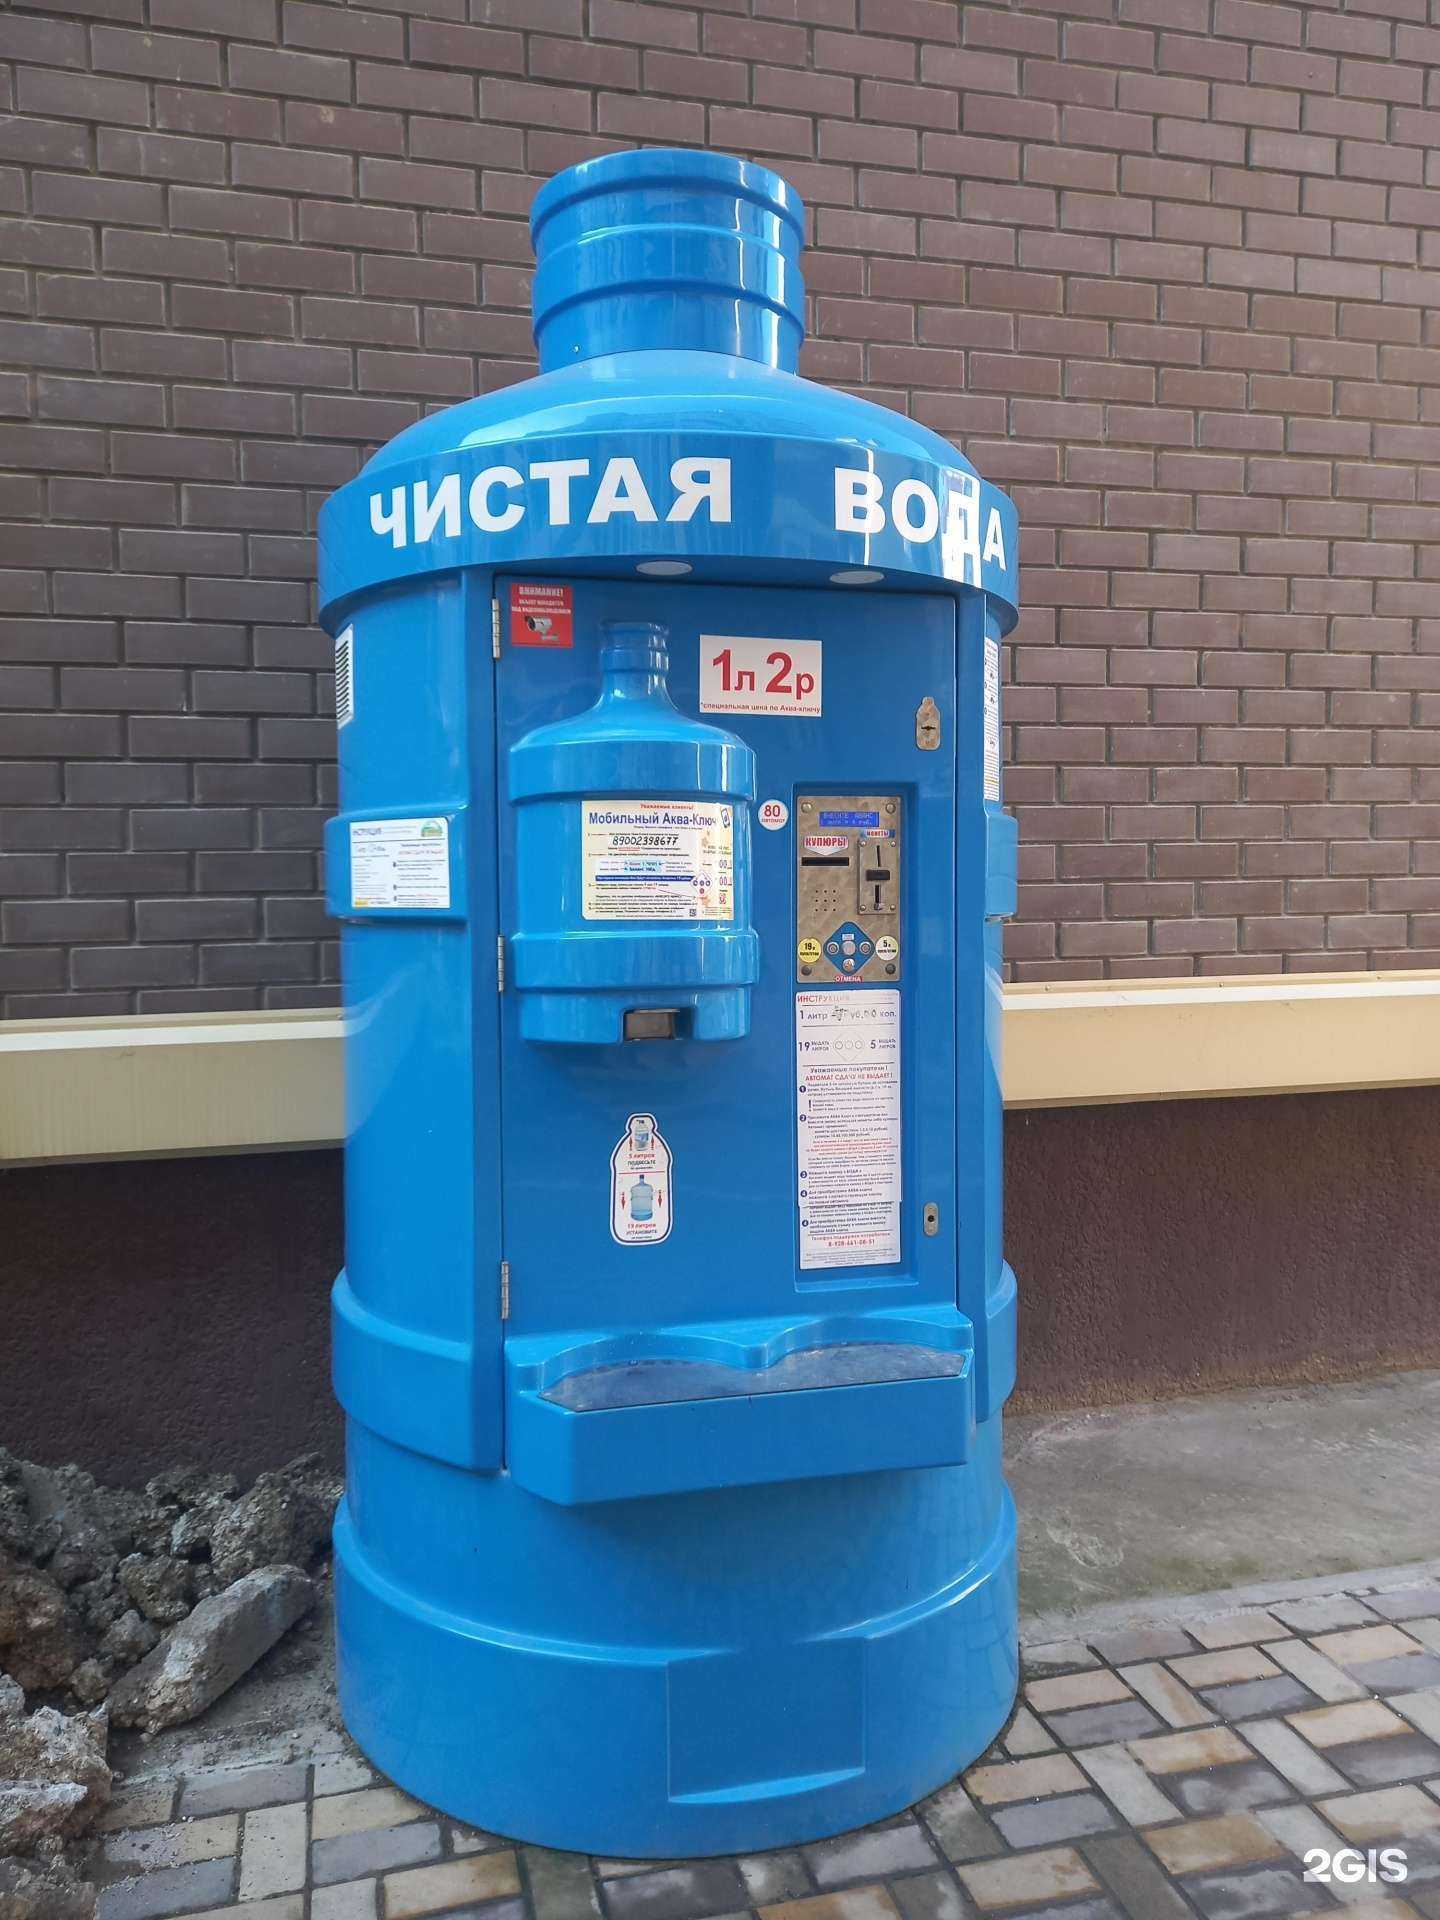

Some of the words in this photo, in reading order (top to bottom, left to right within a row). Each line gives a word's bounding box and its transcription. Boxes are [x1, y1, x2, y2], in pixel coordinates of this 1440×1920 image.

[370, 456, 732, 549] ЧИСТАЯ
[834, 467, 1006, 571] ВОДА
[764, 804, 780, 816] 80
[589, 811, 658, 824] Мобильный
[662, 812, 716, 826] Аква-Ключ
[805, 837, 846, 846] КУПЮРЫ
[804, 942, 812, 950] 19
[799, 1042, 810, 1051] 19
[870, 1040, 876, 1049] 5
